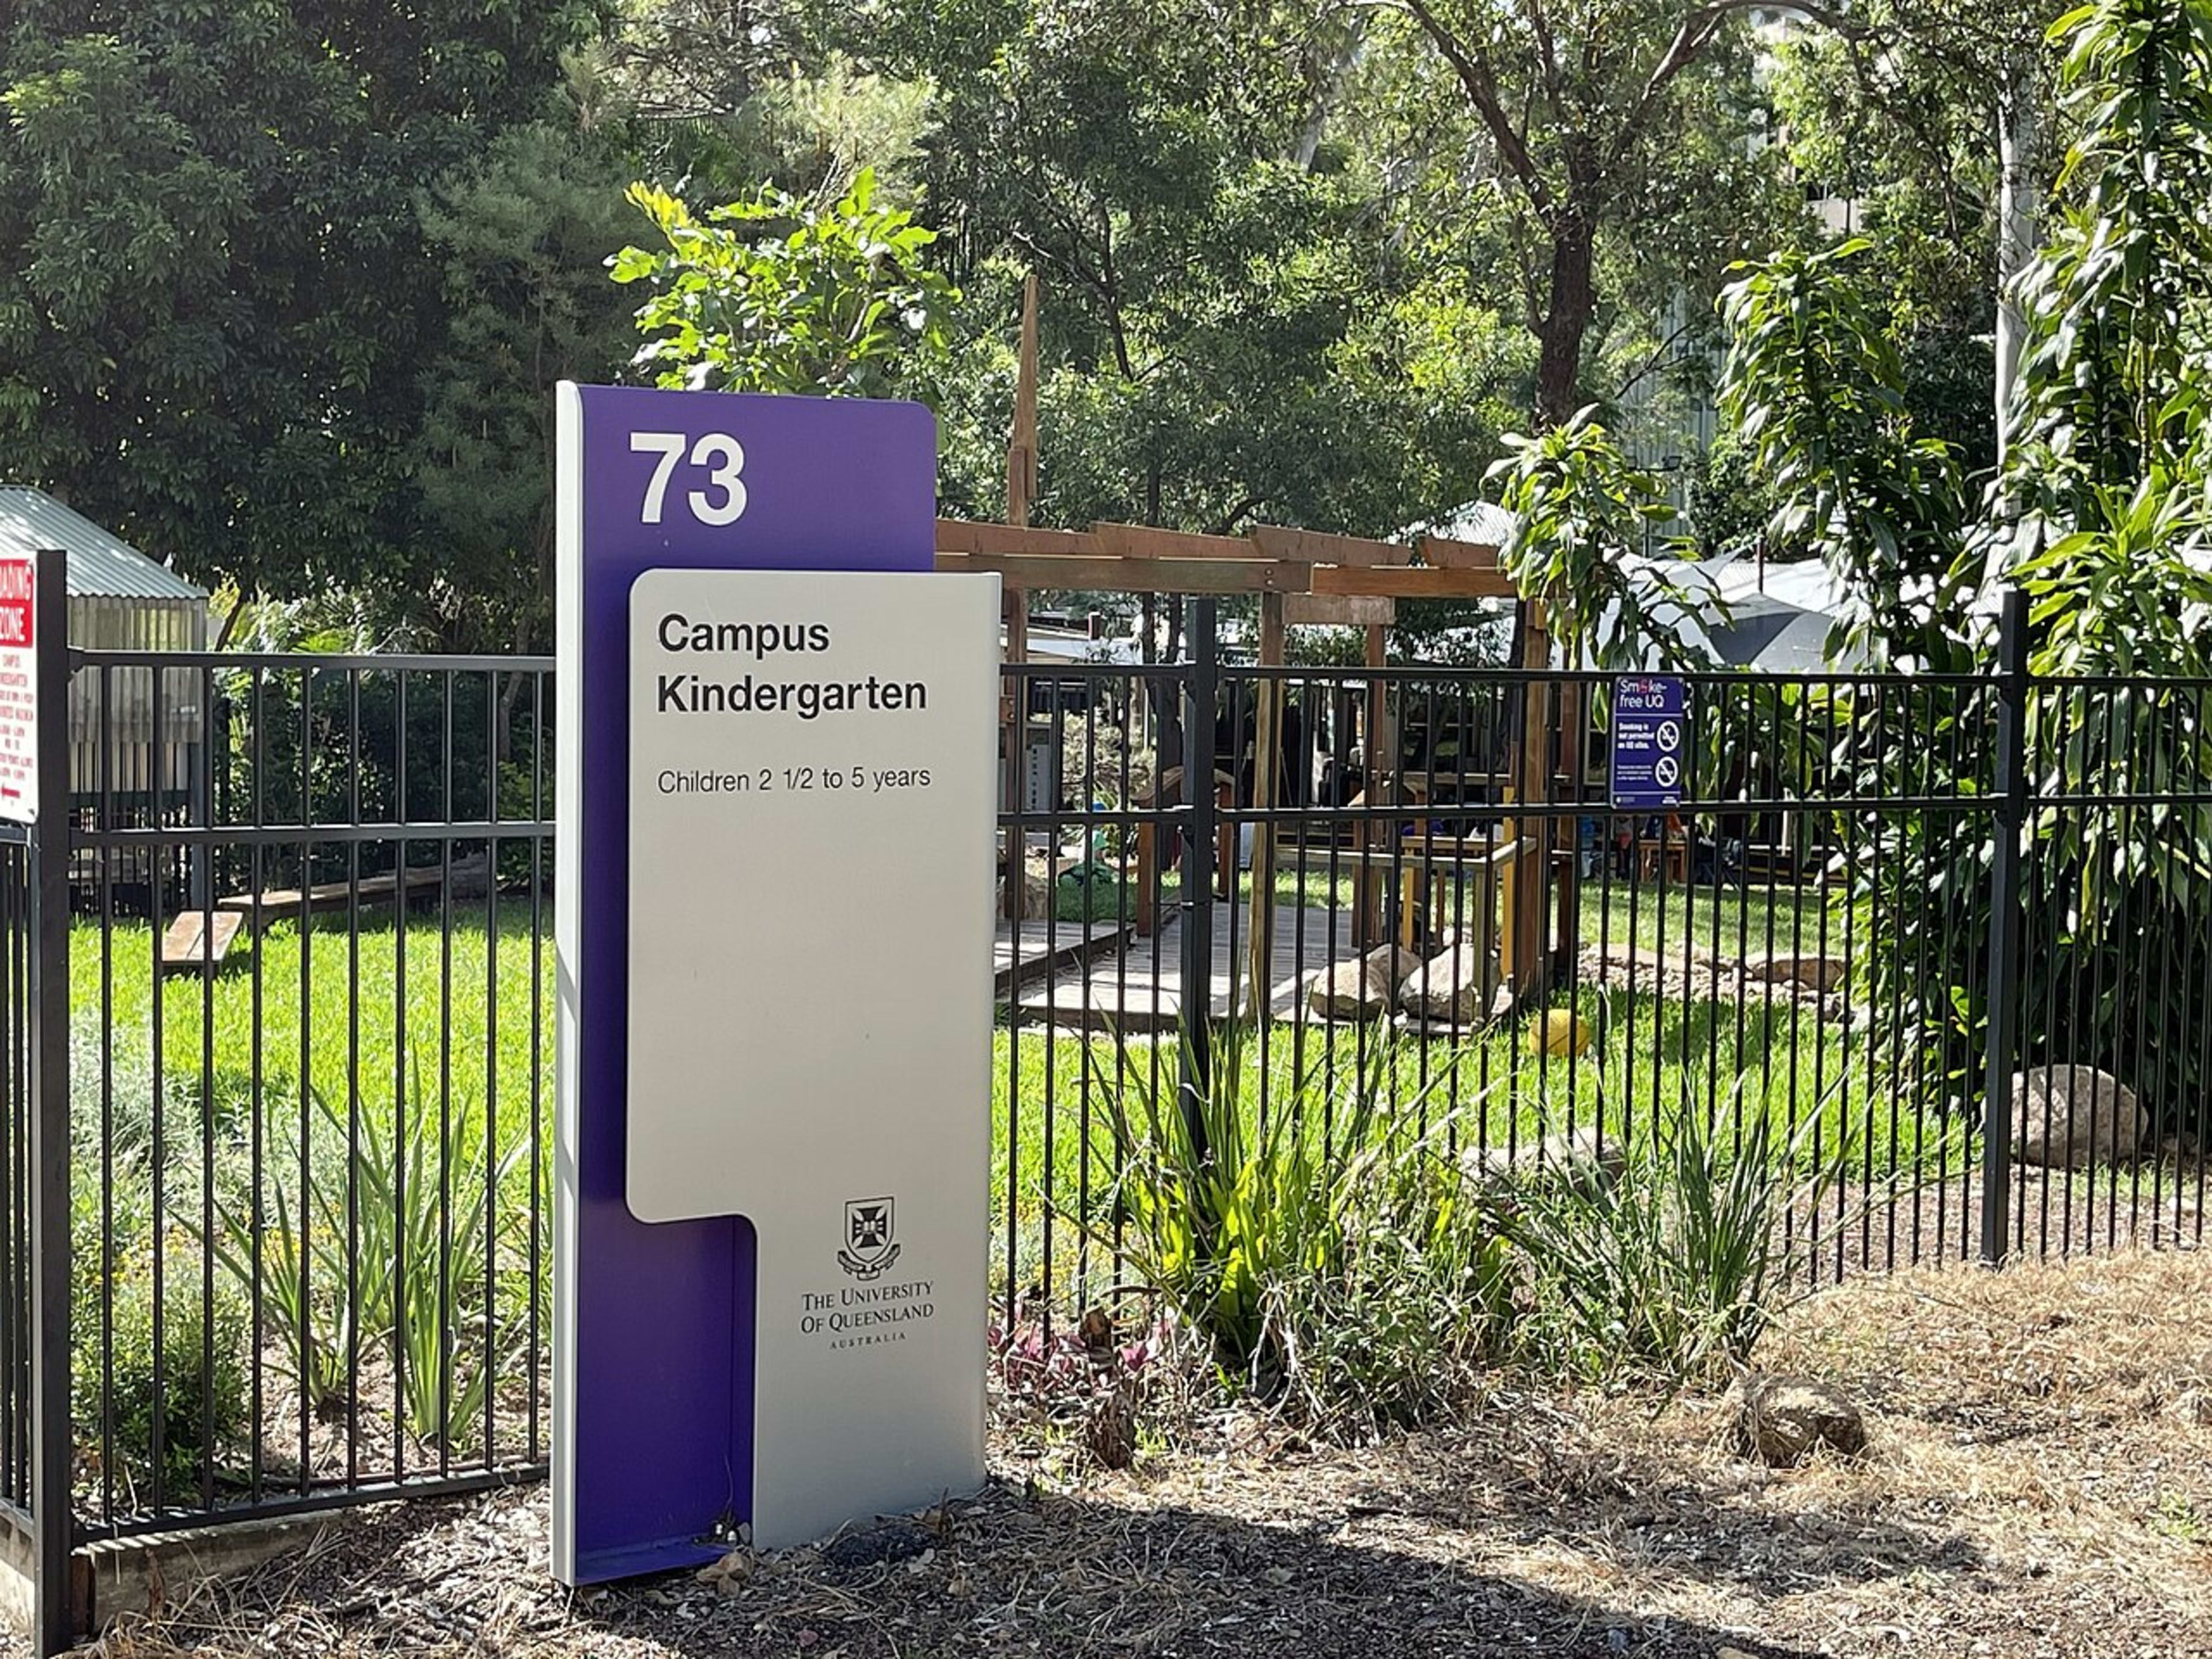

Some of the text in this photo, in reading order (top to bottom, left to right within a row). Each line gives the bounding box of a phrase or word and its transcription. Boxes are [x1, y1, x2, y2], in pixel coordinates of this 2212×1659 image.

[631, 433, 747, 525] 73
[658, 613, 830, 661] Campus
[658, 675, 926, 720] Kindergarten
[1620, 694, 1665, 708] free UQ
[658, 766, 931, 794] Children 2 1/2 to 5 years
[801, 1281, 934, 1311] THE UNIVERSITY
[801, 1304, 934, 1334] OF QUEENSLAND
[830, 1332, 906, 1349] AUSTRALIA
